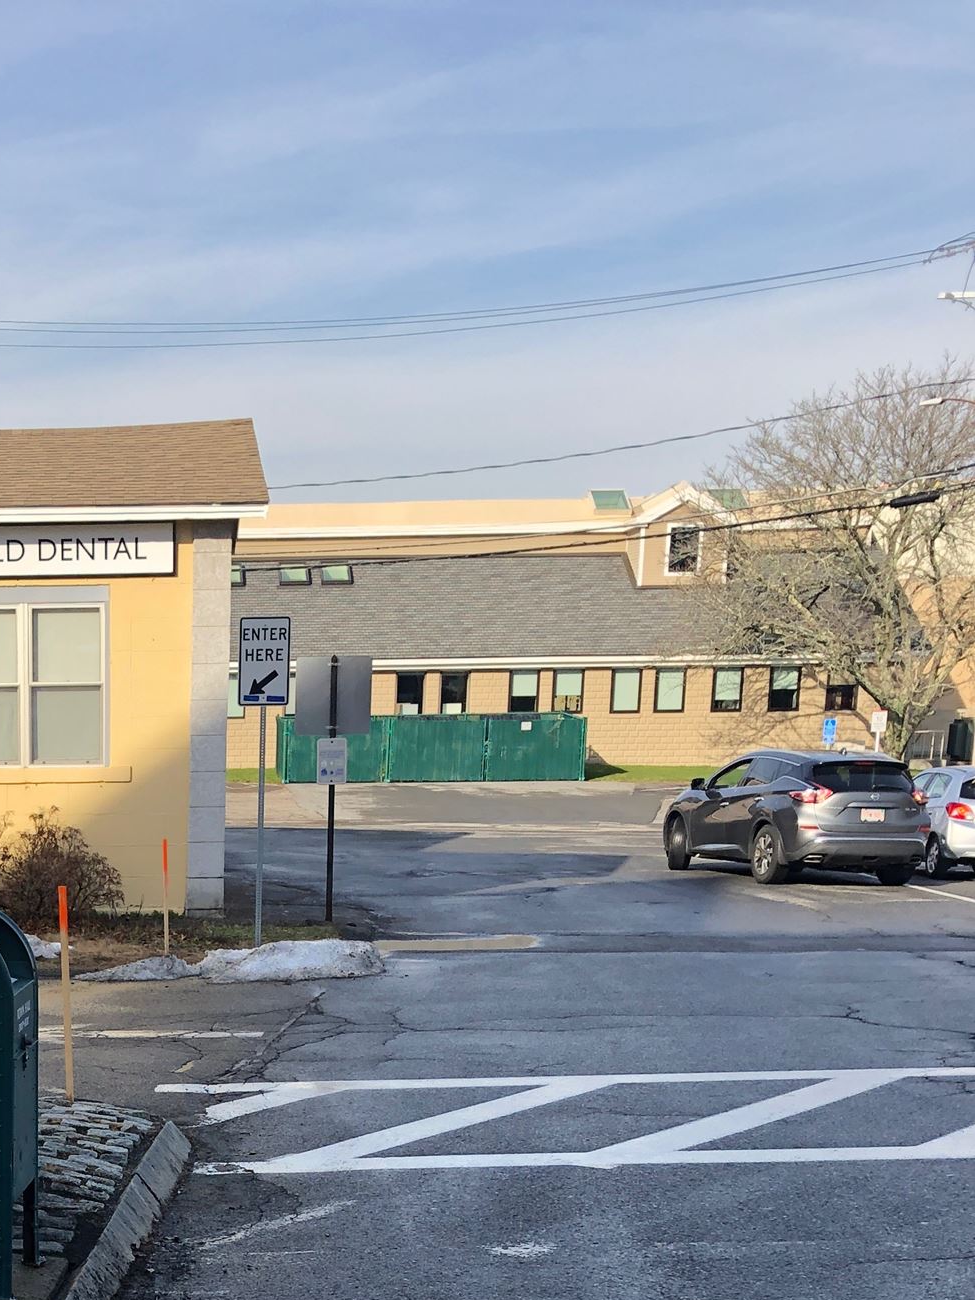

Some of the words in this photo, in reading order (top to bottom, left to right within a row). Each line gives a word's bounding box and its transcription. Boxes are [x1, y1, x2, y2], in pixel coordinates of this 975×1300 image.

[38, 537, 147, 562] DENTAL
[243, 627, 287, 641] ENTER
[245, 648, 284, 662] HERE
